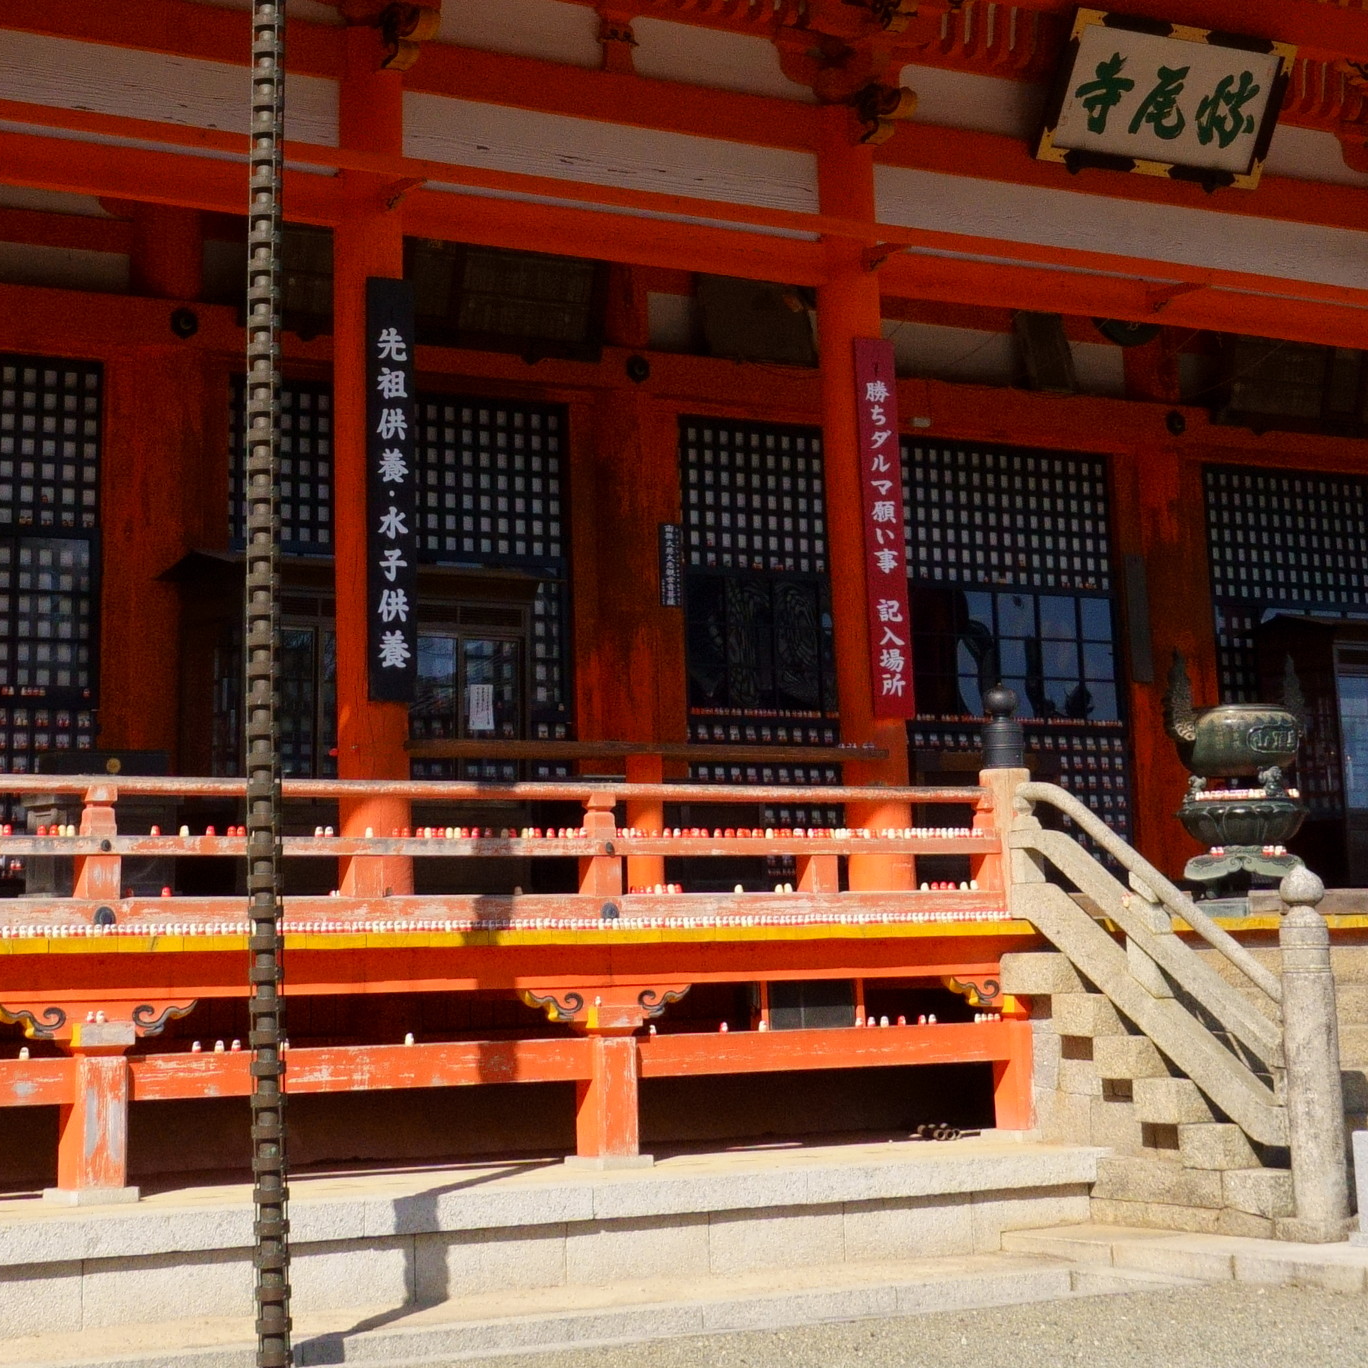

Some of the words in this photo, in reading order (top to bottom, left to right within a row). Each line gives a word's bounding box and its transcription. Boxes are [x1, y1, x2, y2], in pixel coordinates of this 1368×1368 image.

[376, 327, 412, 669] 先祖供養・水子供養
[865, 379, 899, 575] 勝ちダルマ願い事
[876, 597, 907, 698] 記入場所
